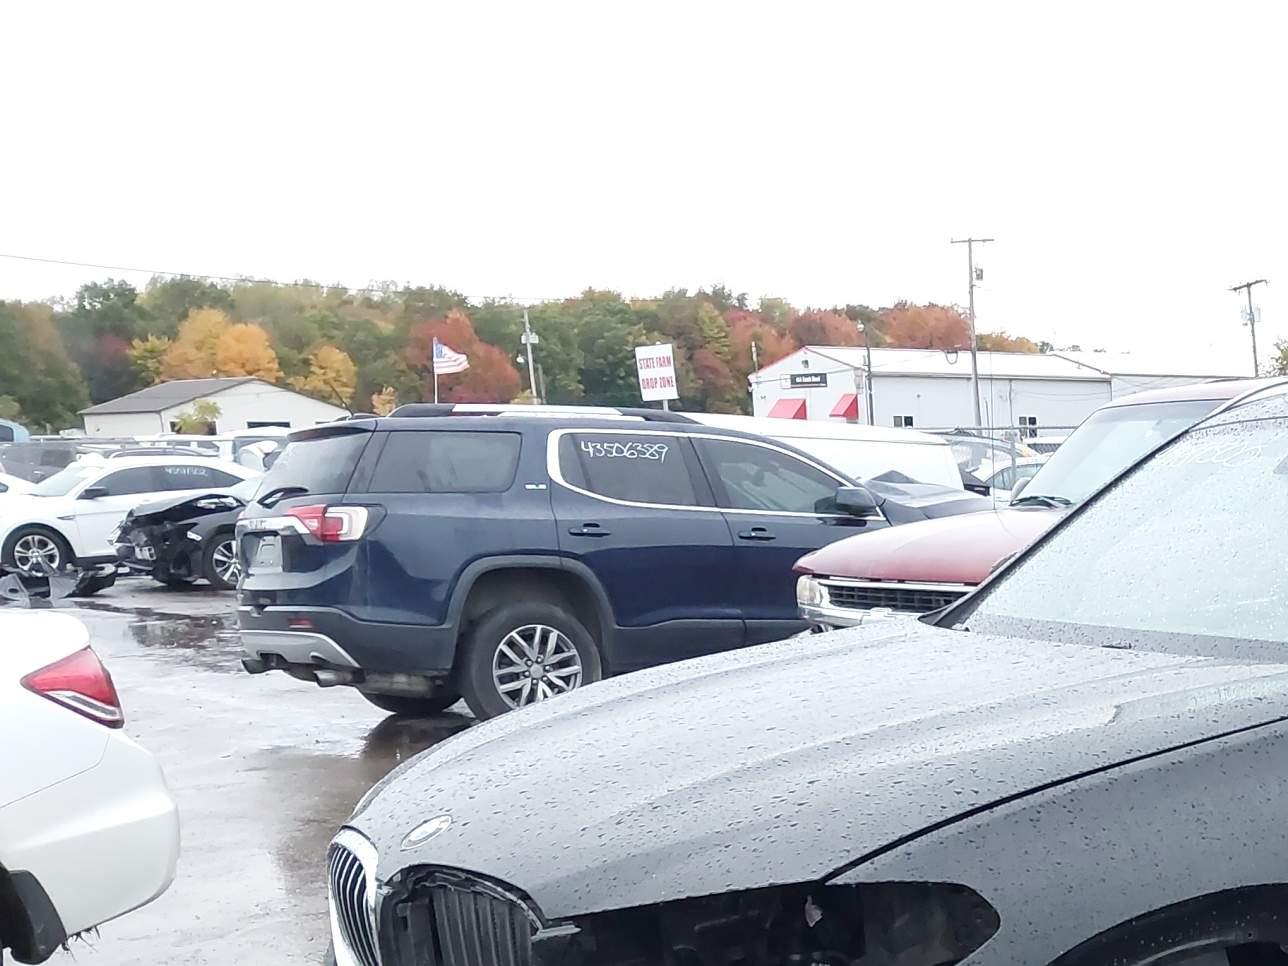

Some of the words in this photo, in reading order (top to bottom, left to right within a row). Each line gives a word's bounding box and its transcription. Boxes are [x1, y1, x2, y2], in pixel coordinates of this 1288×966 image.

[639, 357, 655, 369] STATE
[656, 355, 672, 368] FARM
[641, 377, 657, 389] DROP
[659, 376, 674, 388] ZONE
[581, 440, 668, 463] 43506389
